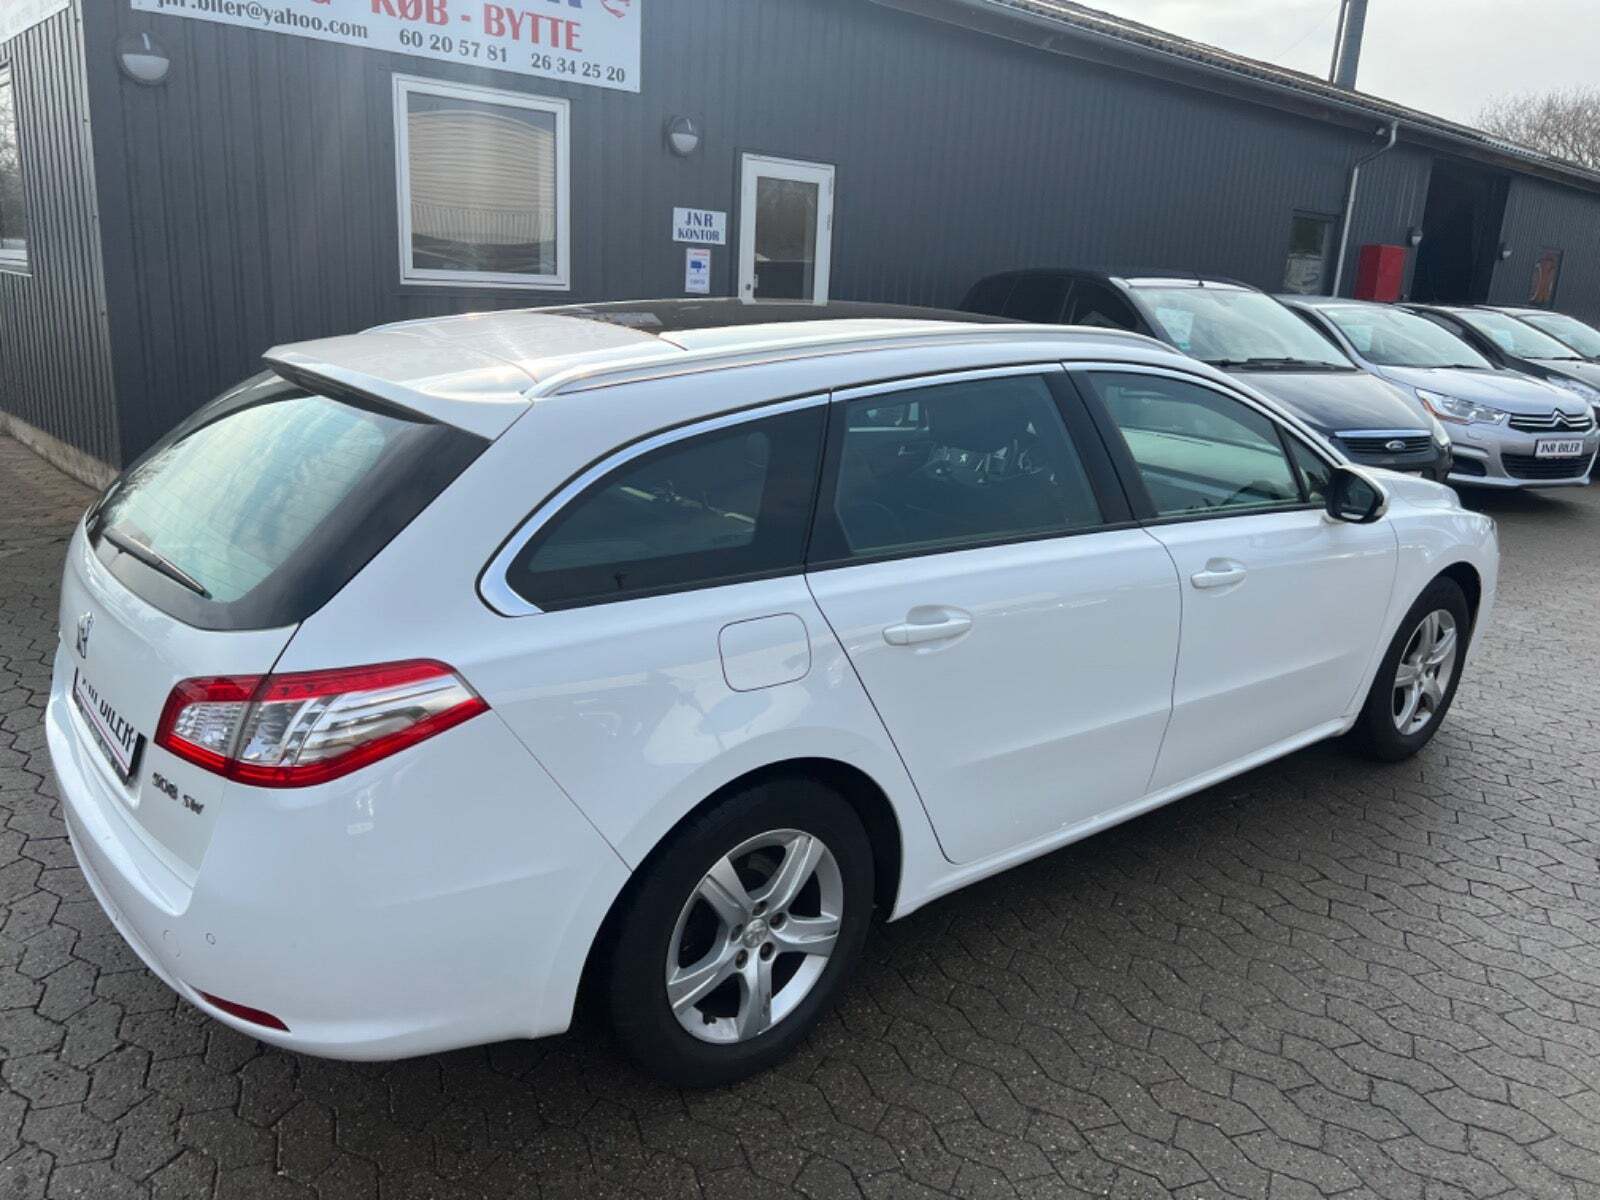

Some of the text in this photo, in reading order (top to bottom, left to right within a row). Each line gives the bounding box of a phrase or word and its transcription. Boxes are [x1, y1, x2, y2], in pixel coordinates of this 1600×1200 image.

[484, 3, 583, 53] BYTTE
[399, 28, 626, 83] 60 20 57 81 26 34 25 20
[678, 227, 720, 242] KONTOR
[684, 211, 713, 227] JNR
